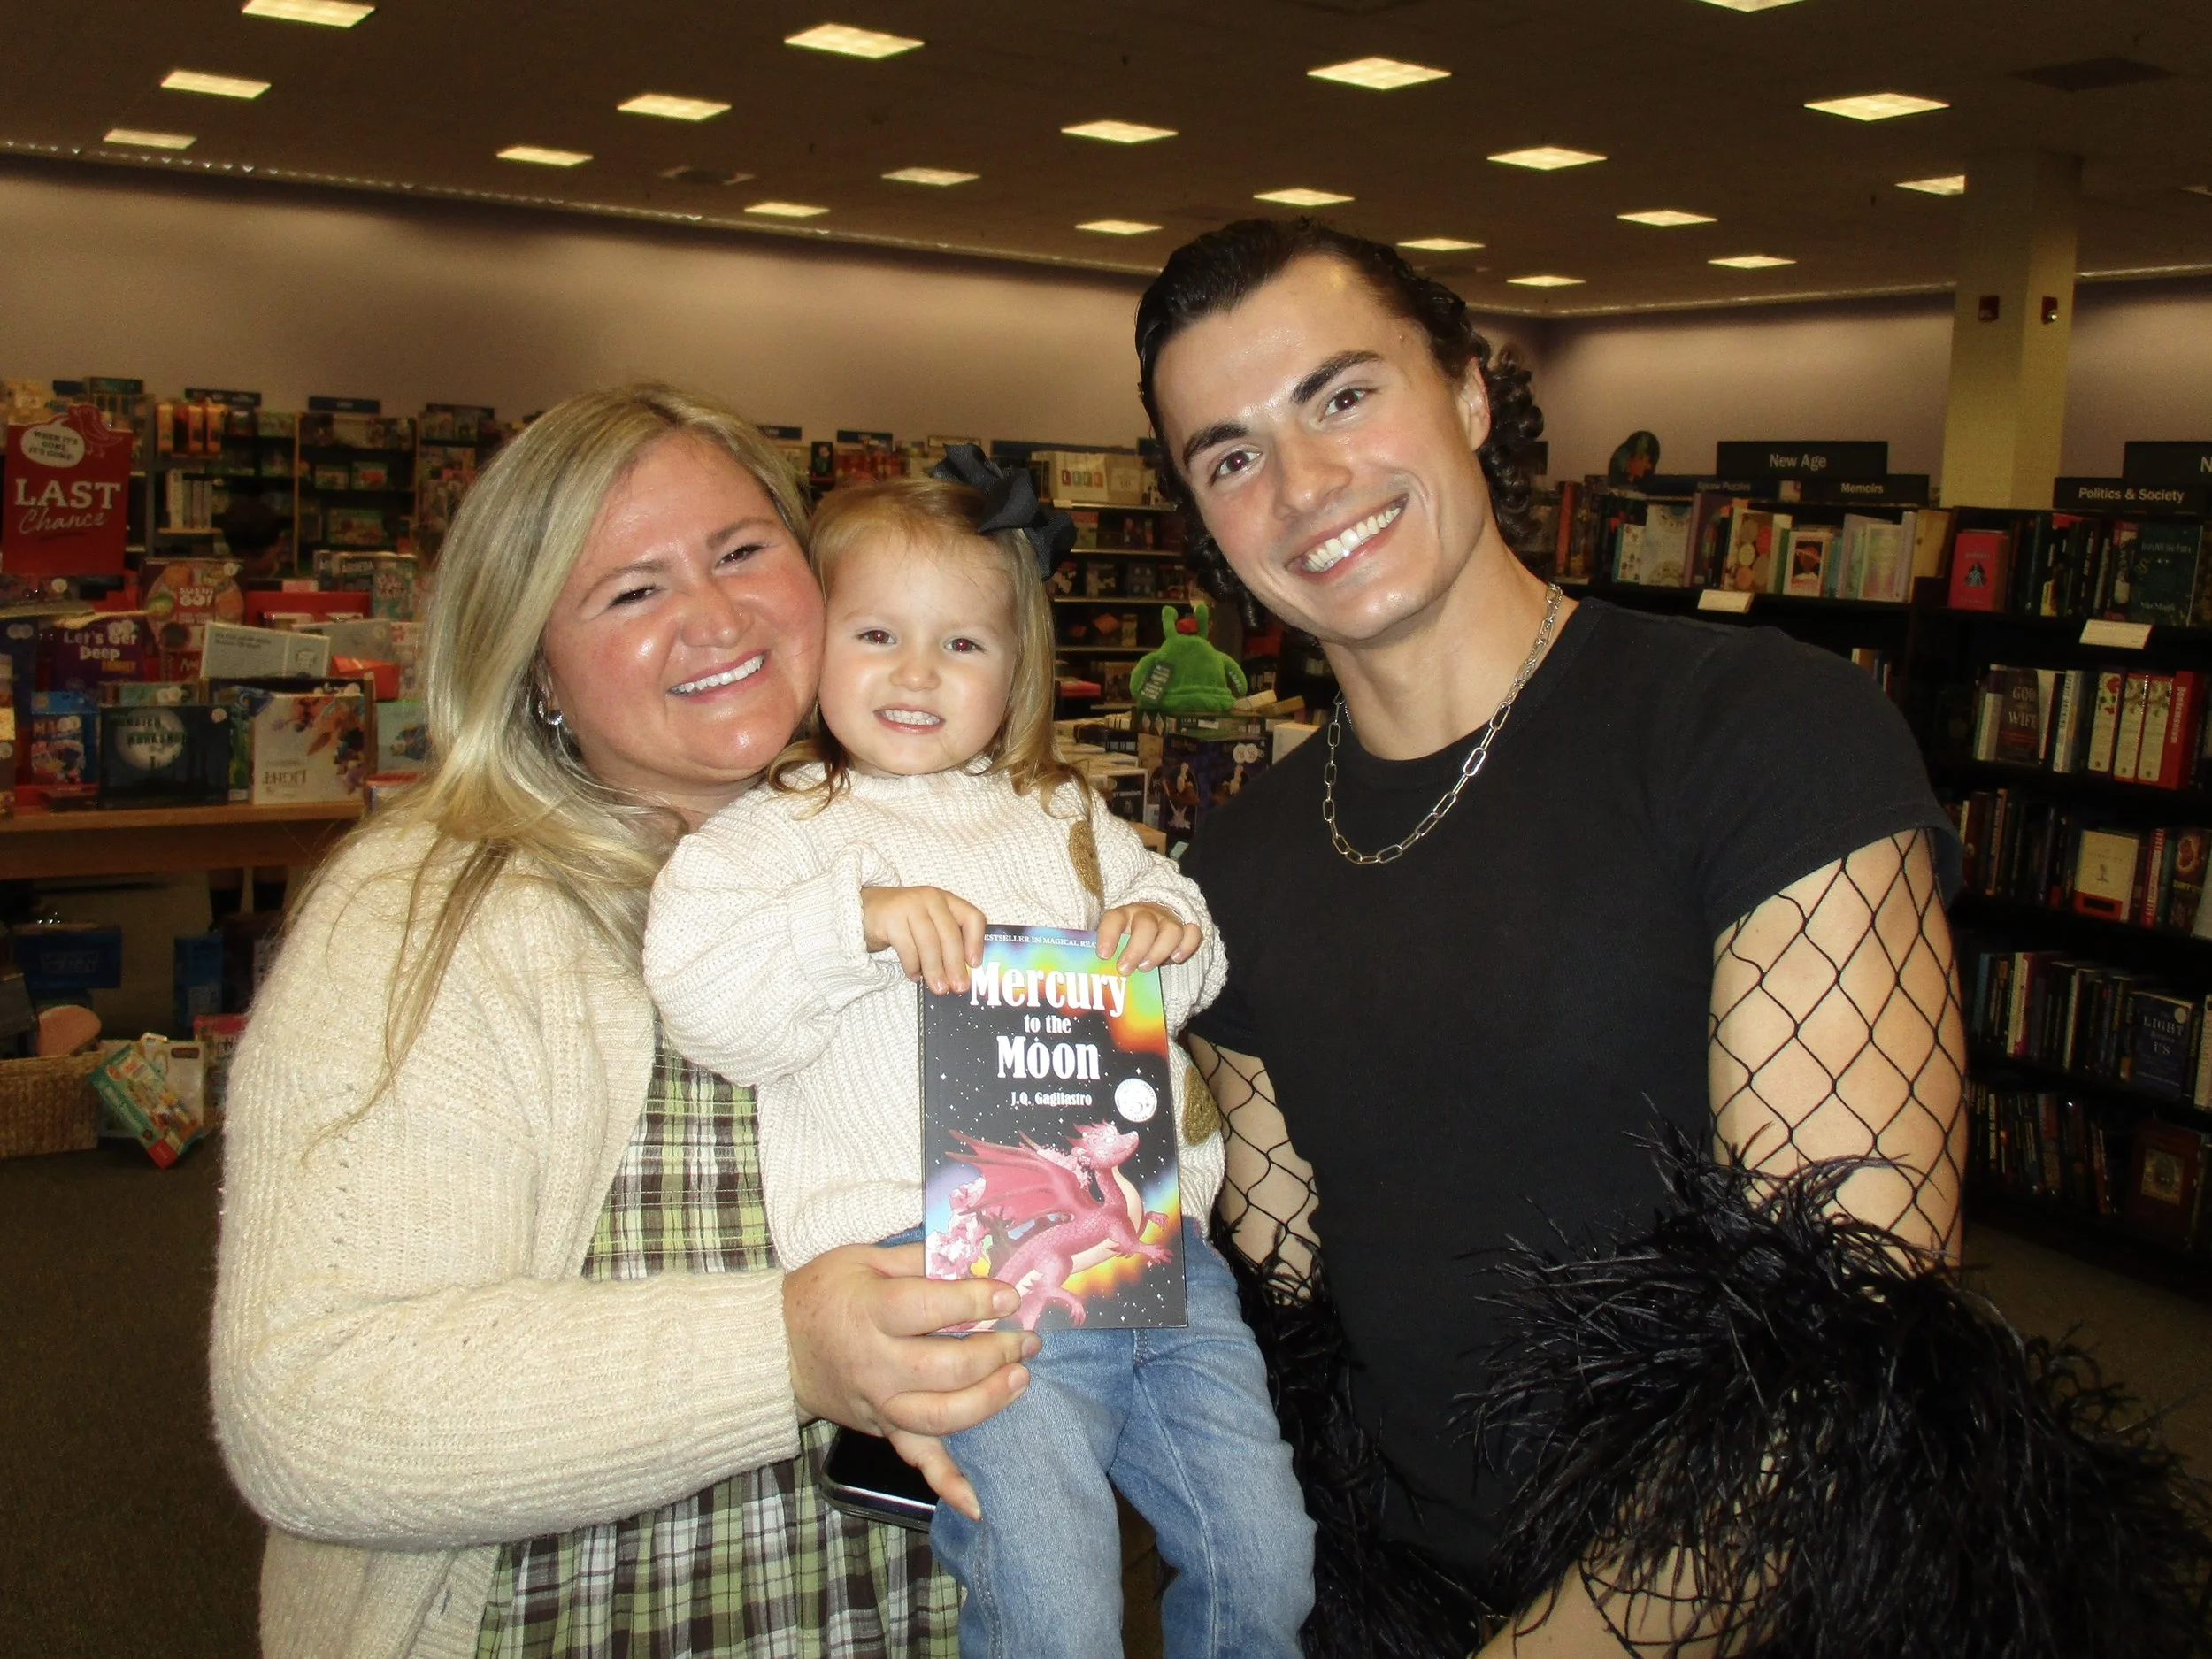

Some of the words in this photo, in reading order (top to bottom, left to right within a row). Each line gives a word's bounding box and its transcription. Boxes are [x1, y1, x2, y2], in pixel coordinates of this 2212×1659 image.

[1770, 453, 1797, 467] New
[1801, 454, 1827, 472] Age
[15, 478, 121, 510] LAST
[1840, 482, 1884, 494] Memoirs
[2078, 487, 2122, 500] Politics
[2124, 488, 2135, 501] &
[2139, 488, 2185, 503] Society
[19, 507, 108, 534] Chance
[64, 629, 105, 646] Let's
[80, 645, 121, 661] Deep
[2008, 710, 2037, 729] WIFE
[984, 933, 1030, 943] ESTSELLER
[1043, 937, 1079, 947] MAGICAL
[969, 962, 1126, 1018] Mercury
[1024, 1014, 1041, 1033] to
[1045, 1014, 1071, 1034] the
[2143, 1014, 2183, 1037] LIGHT
[996, 1035, 1101, 1079] Moon
[1010, 1091, 1032, 1107] J.Q.
[1034, 1091, 1093, 1107] Gagliastro
